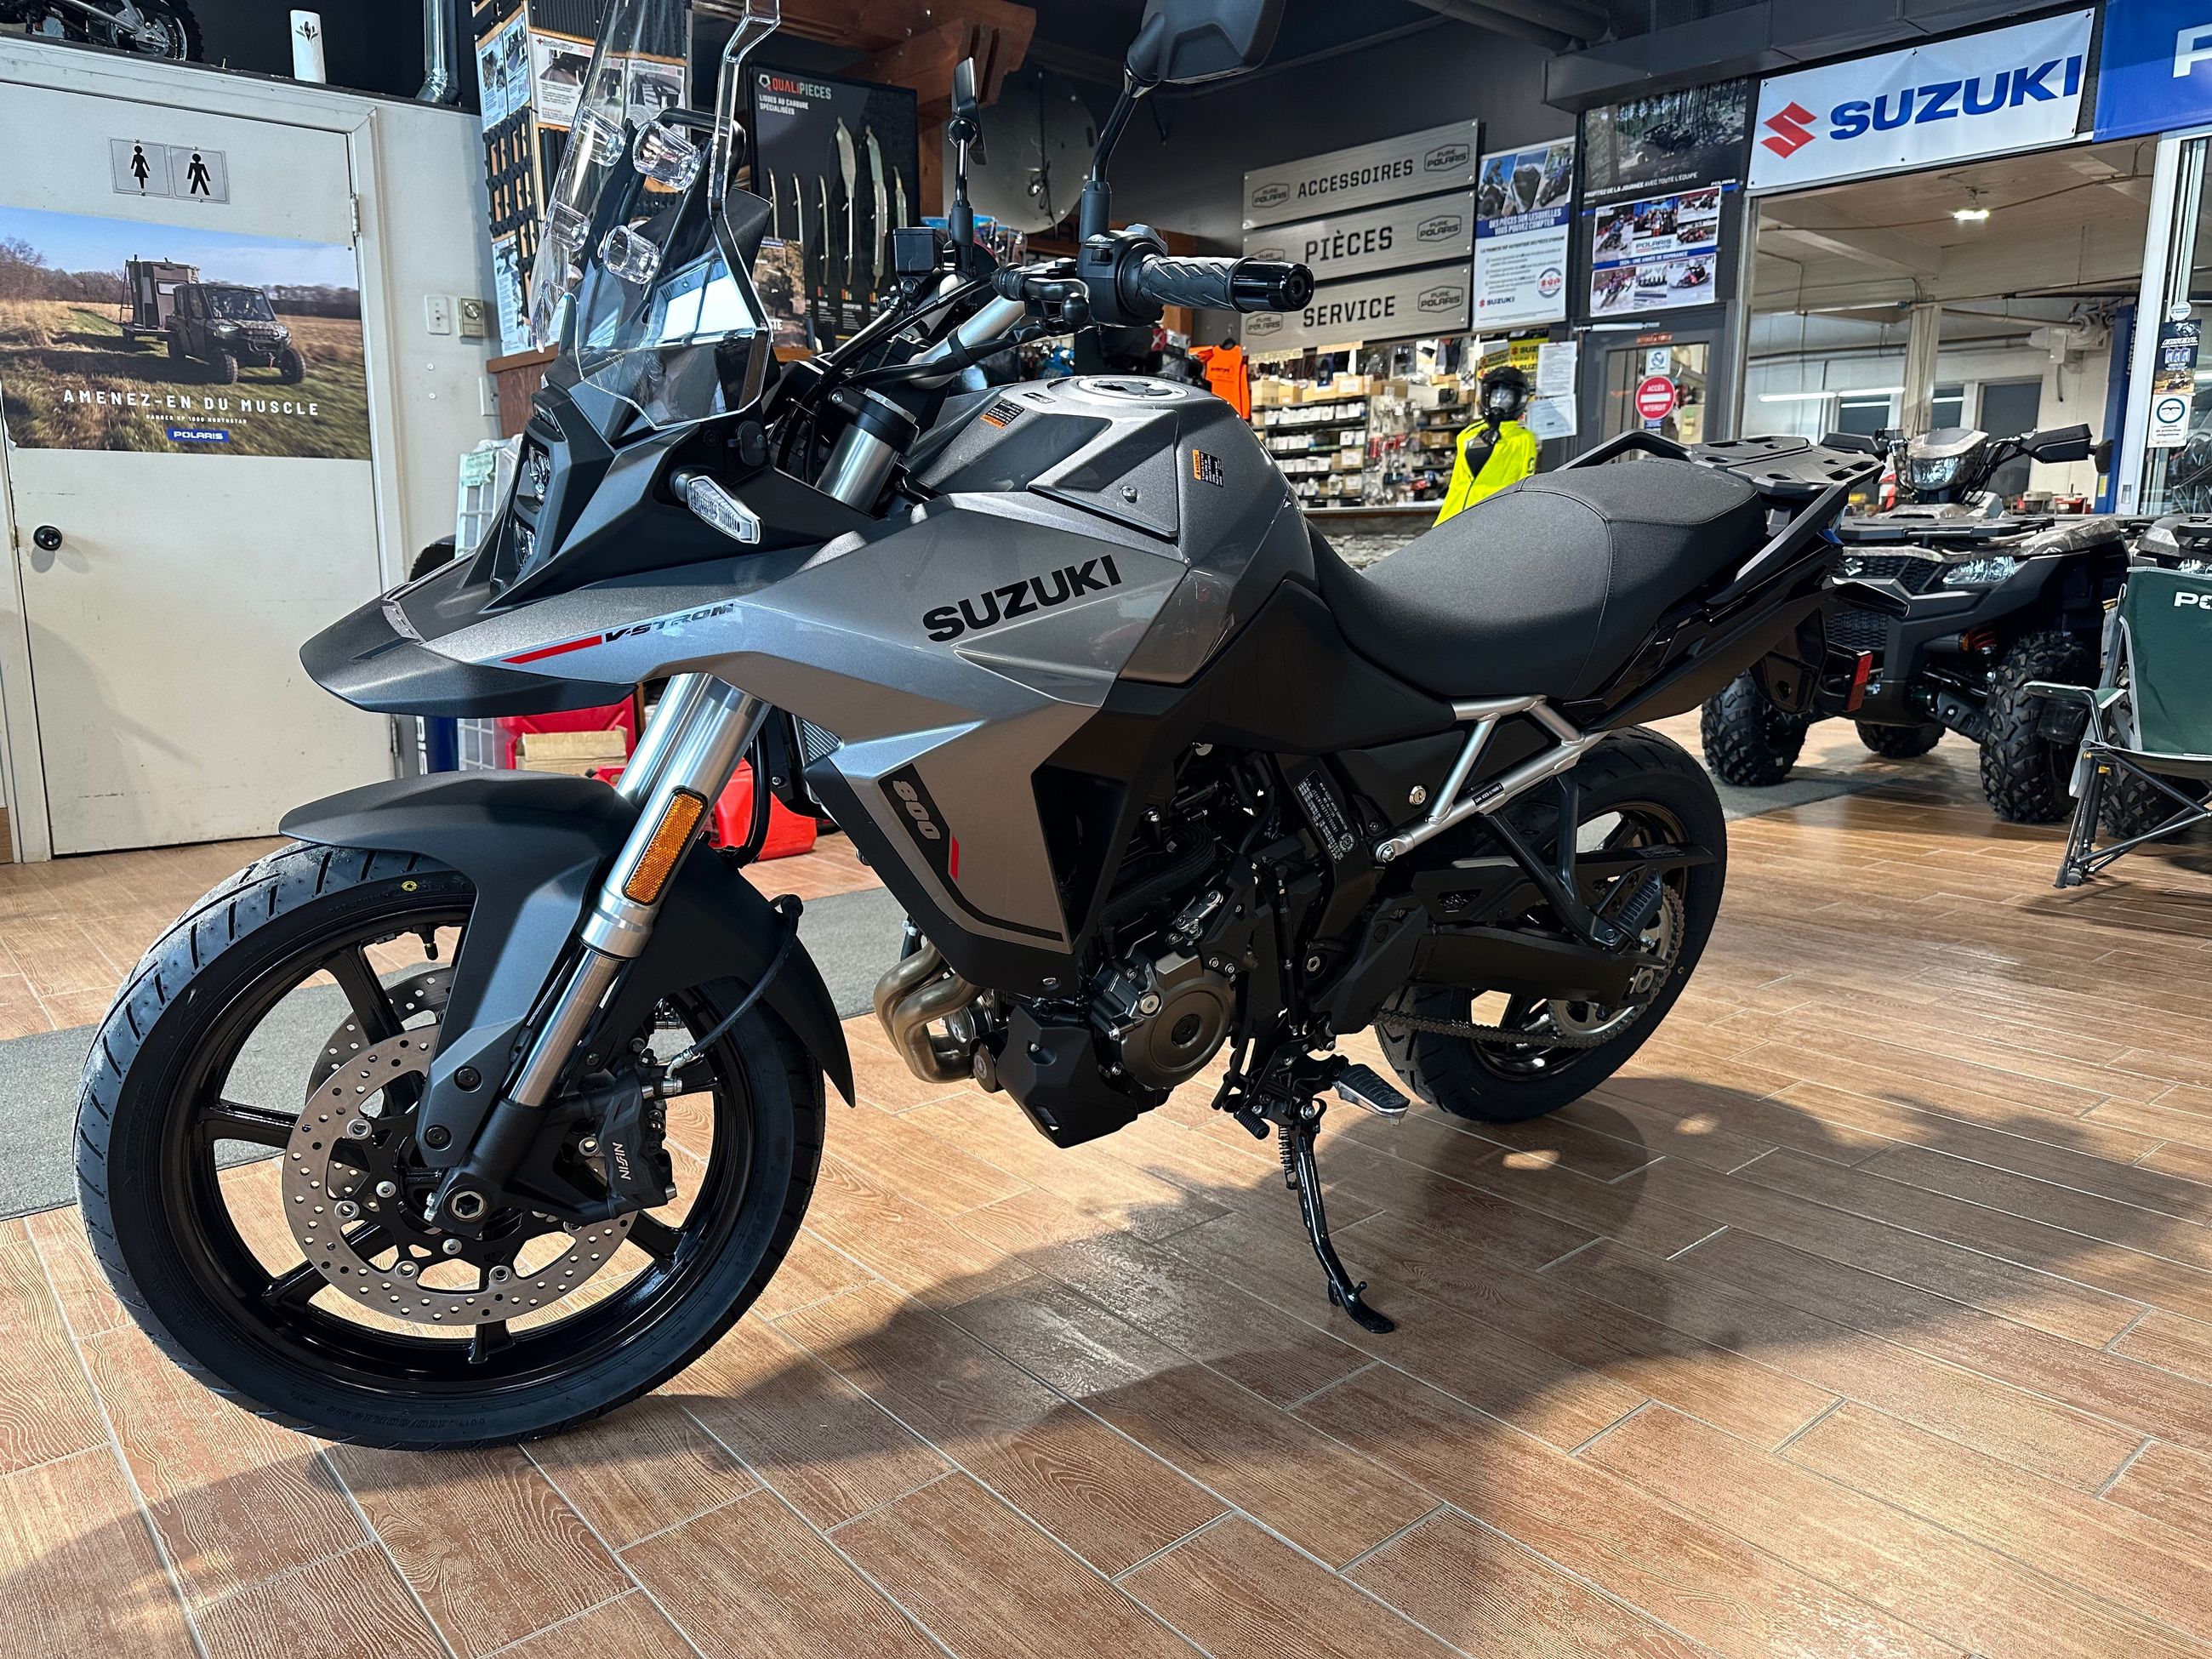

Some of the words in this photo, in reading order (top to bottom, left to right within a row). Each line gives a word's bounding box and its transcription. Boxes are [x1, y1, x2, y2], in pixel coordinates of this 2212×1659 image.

[1829, 54, 2083, 140] SUZUKI
[1427, 153, 1467, 168] POLARIS
[1297, 159, 1413, 198] ACCESSOIRES
[1254, 191, 1286, 203] POLARIS
[1420, 224, 1459, 237] POLARIS
[1305, 226, 1393, 264] PIÈCES
[1421, 294, 1460, 308] POLARIS
[1486, 296, 1515, 306] SUZUKI
[1303, 296, 1395, 328] SERVICE
[1248, 321, 1280, 330] POLARIS
[1646, 384, 1666, 393] ACCÈS
[63, 389, 191, 409] AMENEZ-EN
[204, 397, 228, 411] DU
[241, 399, 319, 416] MUSCLE
[1643, 404, 1668, 413] INTERDIT
[174, 430, 224, 440] POLARIS
[922, 554, 1122, 642] SUZUKI
[606, 603, 734, 642] V-STROM
[892, 780, 940, 840] 800
[612, 1142, 631, 1181] NISSIN
